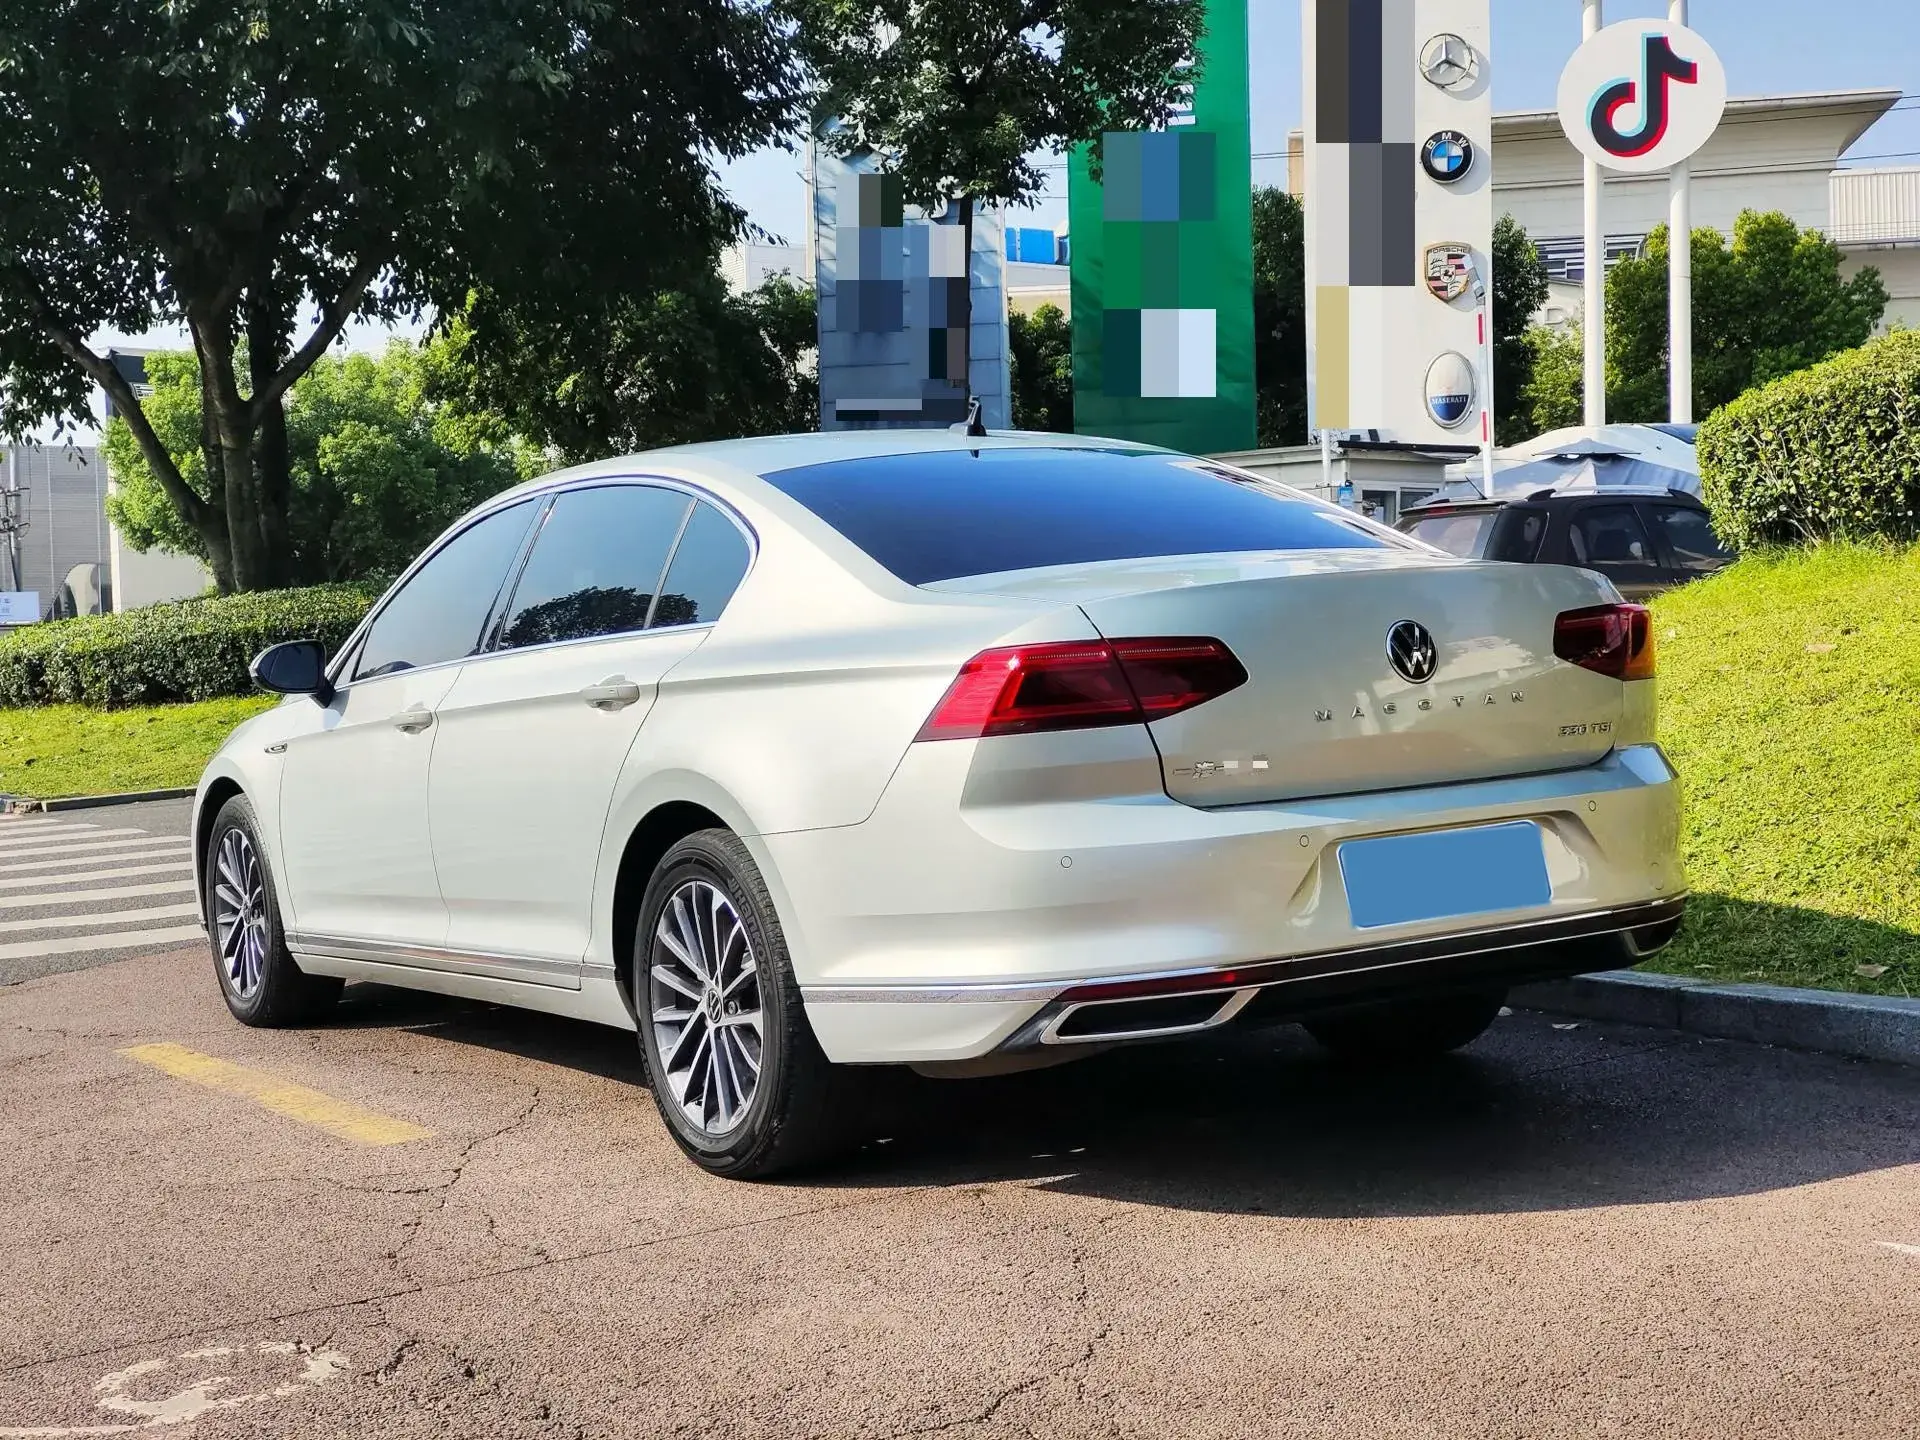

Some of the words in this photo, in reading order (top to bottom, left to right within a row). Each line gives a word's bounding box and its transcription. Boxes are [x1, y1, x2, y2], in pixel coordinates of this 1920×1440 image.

[1425, 132, 1470, 149] BMW
[1430, 396, 1467, 404] MASERATI
[1313, 690, 1525, 722] MAGOTAN
